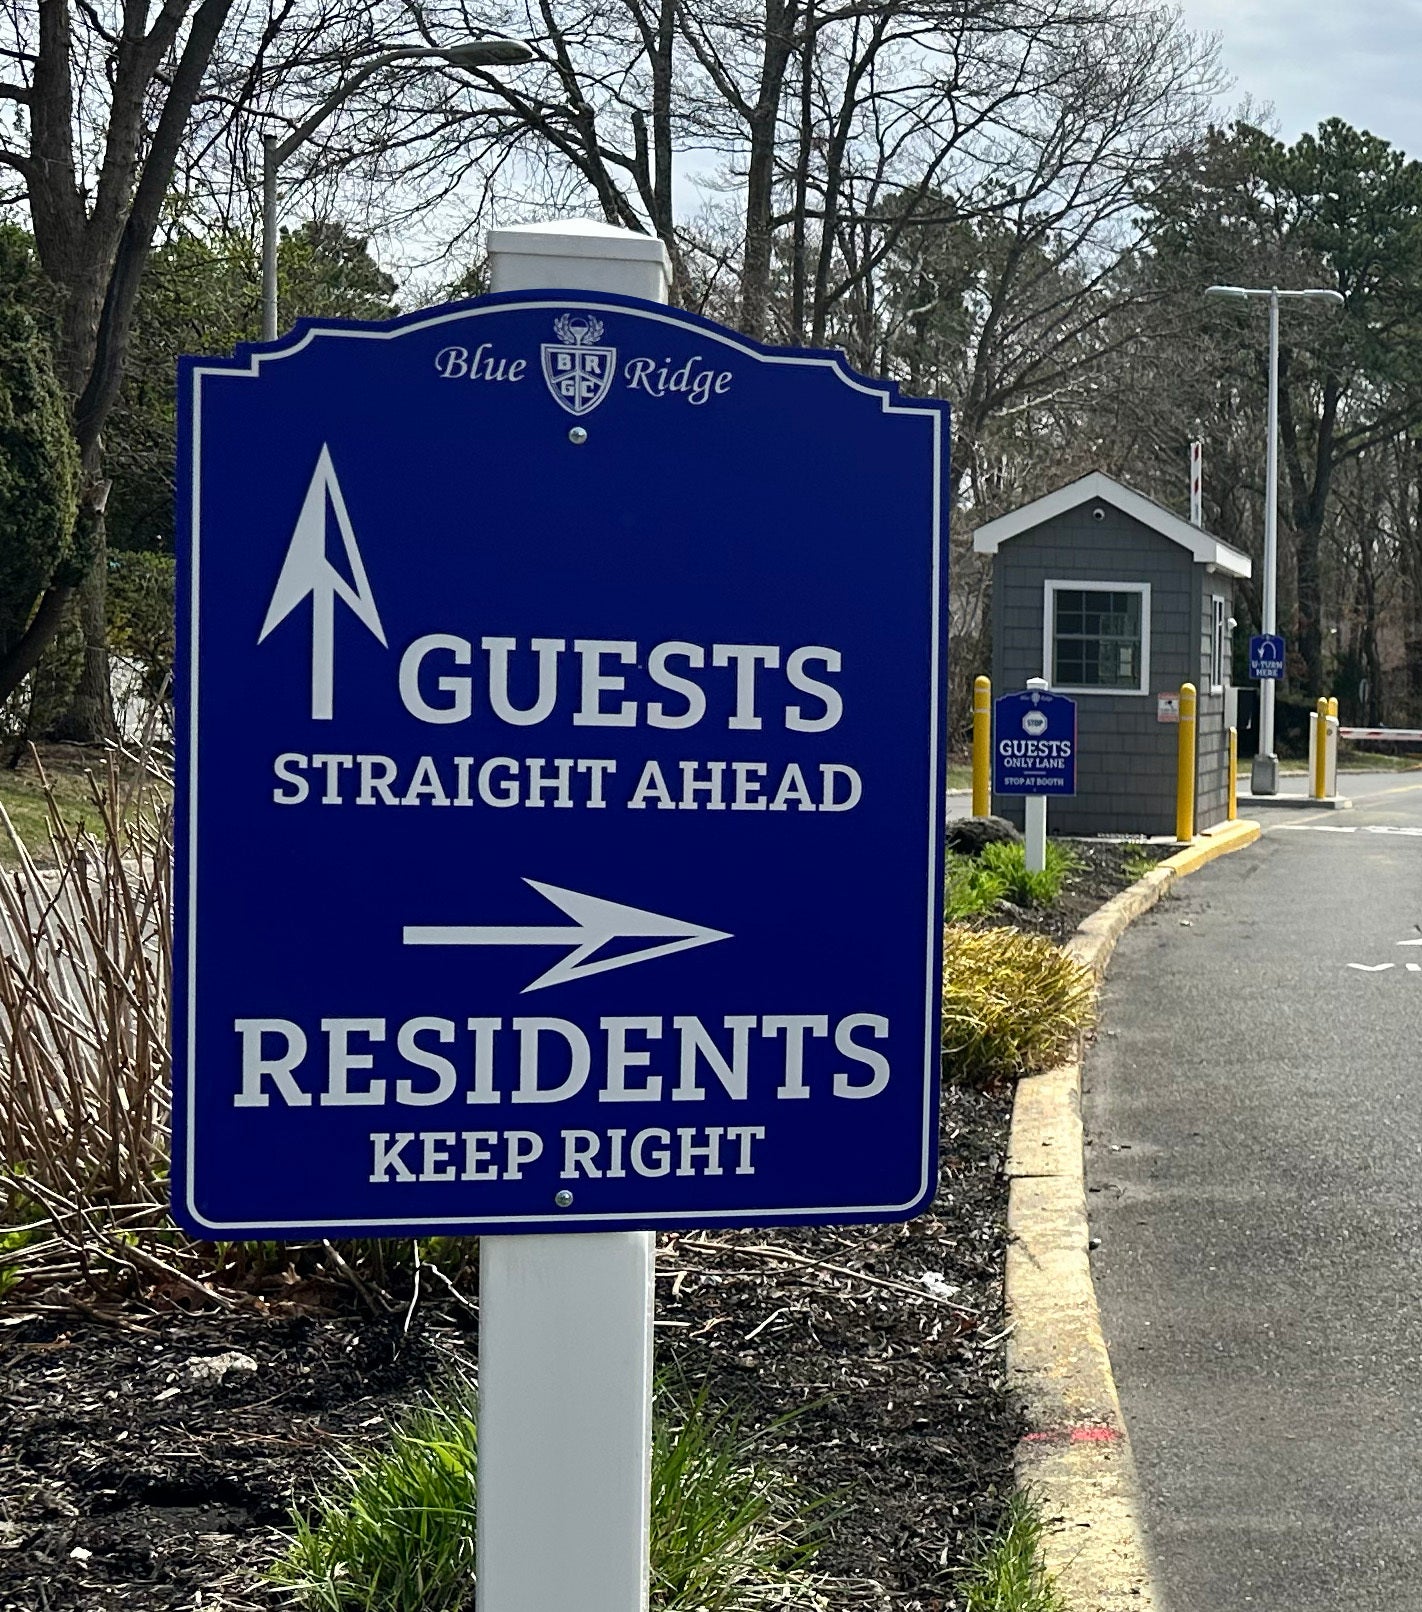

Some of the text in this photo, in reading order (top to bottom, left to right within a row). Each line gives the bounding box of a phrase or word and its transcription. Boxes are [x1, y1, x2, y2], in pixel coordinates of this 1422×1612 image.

[435, 343, 733, 405] Blue Ridge
[398, 633, 843, 733] GUESTS
[1251, 660, 1283, 669] U-TURN
[1026, 719, 1043, 727] STOP
[999, 739, 1071, 757] GUESTS
[1003, 757, 1065, 769] ONLY LANE
[273, 752, 862, 812] STRAIGHT AHEAD
[1004, 777, 1064, 787] STOP AT BOOTH
[233, 1014, 892, 1107] RESIDENTS
[369, 1126, 766, 1184] KEEP RIGHT
